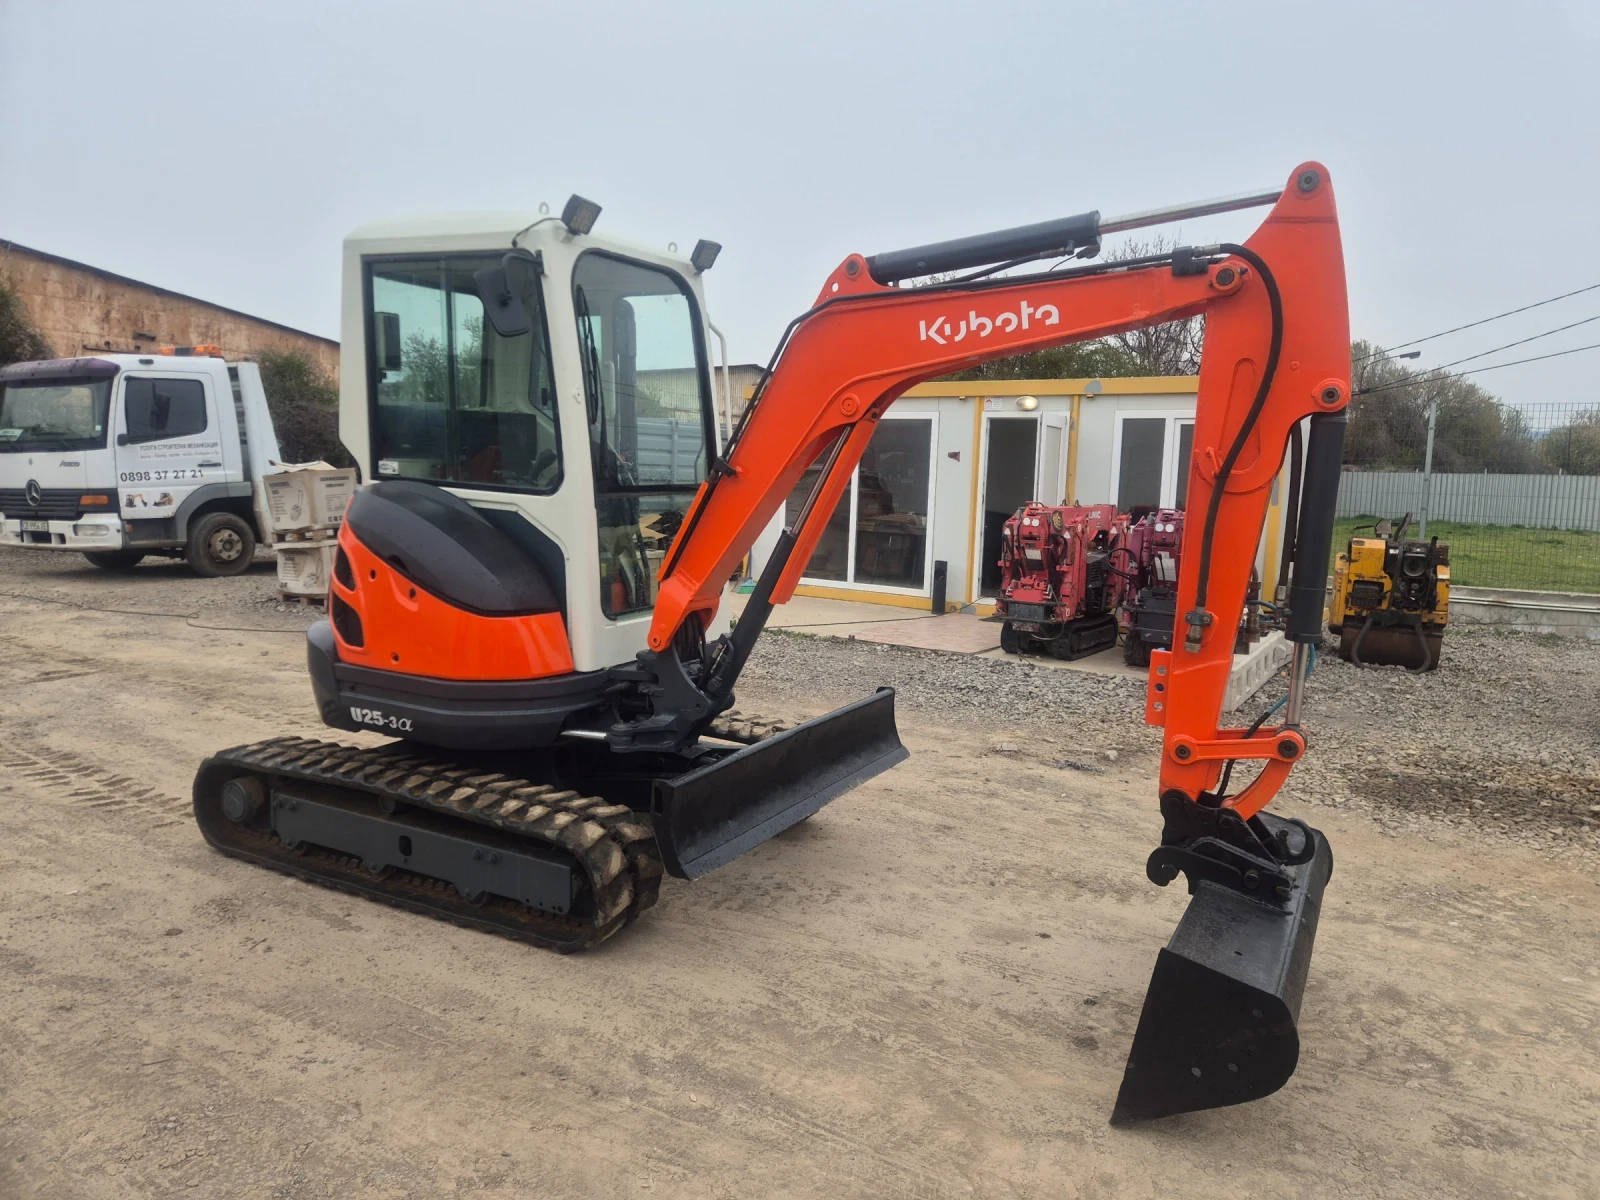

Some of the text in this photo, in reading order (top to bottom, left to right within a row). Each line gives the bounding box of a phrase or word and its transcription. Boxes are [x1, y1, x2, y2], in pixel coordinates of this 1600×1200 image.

[919, 300, 1060, 345] Kubota
[139, 444, 157, 452] УСЛУГИ
[120, 469, 204, 482] 0898 37 27 21
